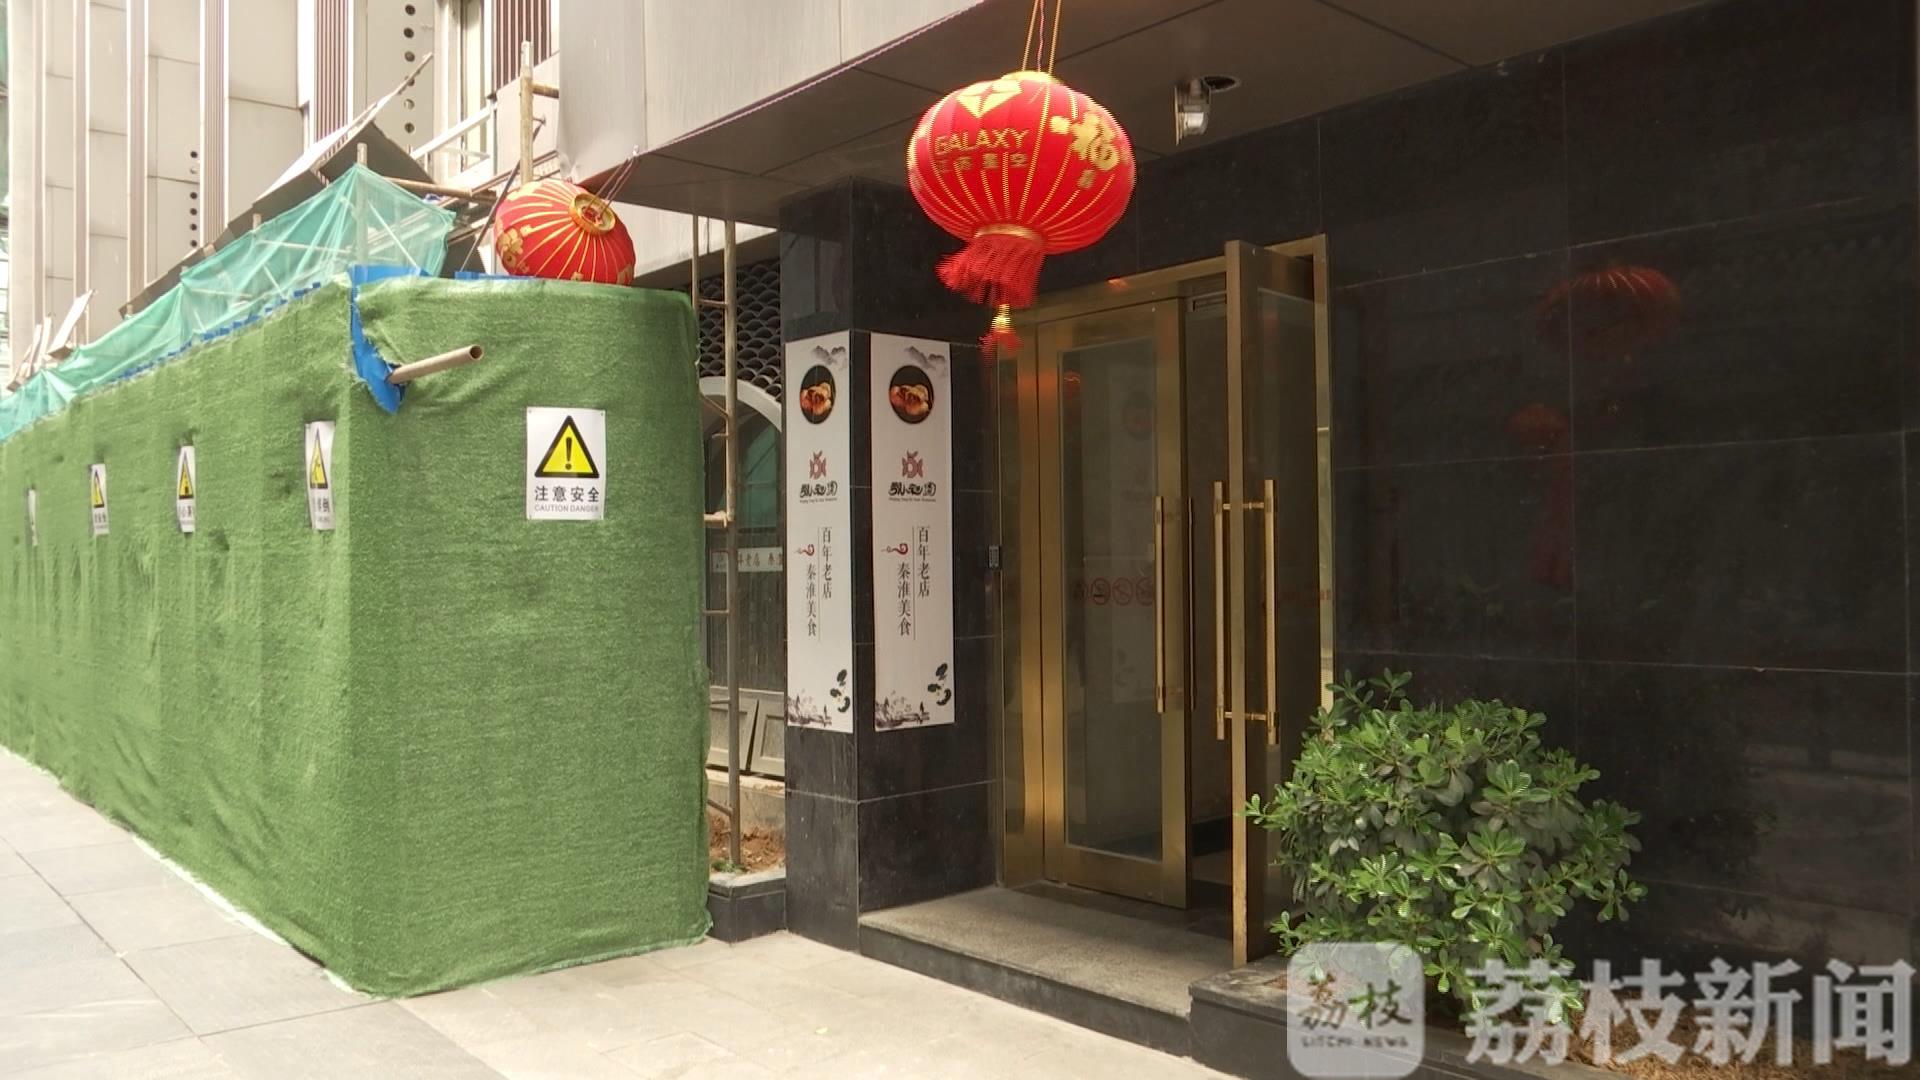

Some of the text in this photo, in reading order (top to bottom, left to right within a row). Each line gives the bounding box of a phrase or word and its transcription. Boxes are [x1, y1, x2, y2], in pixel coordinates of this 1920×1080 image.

[935, 128, 1030, 155] GALAXY
[534, 485, 600, 503] 注意安全
[534, 503, 599, 513] CAUTION DANGER
[821, 526, 833, 600] 百年老店
[917, 526, 931, 598] 百年老店
[805, 563, 818, 637] 秦淮美食
[897, 562, 911, 637] 秦淮美食
